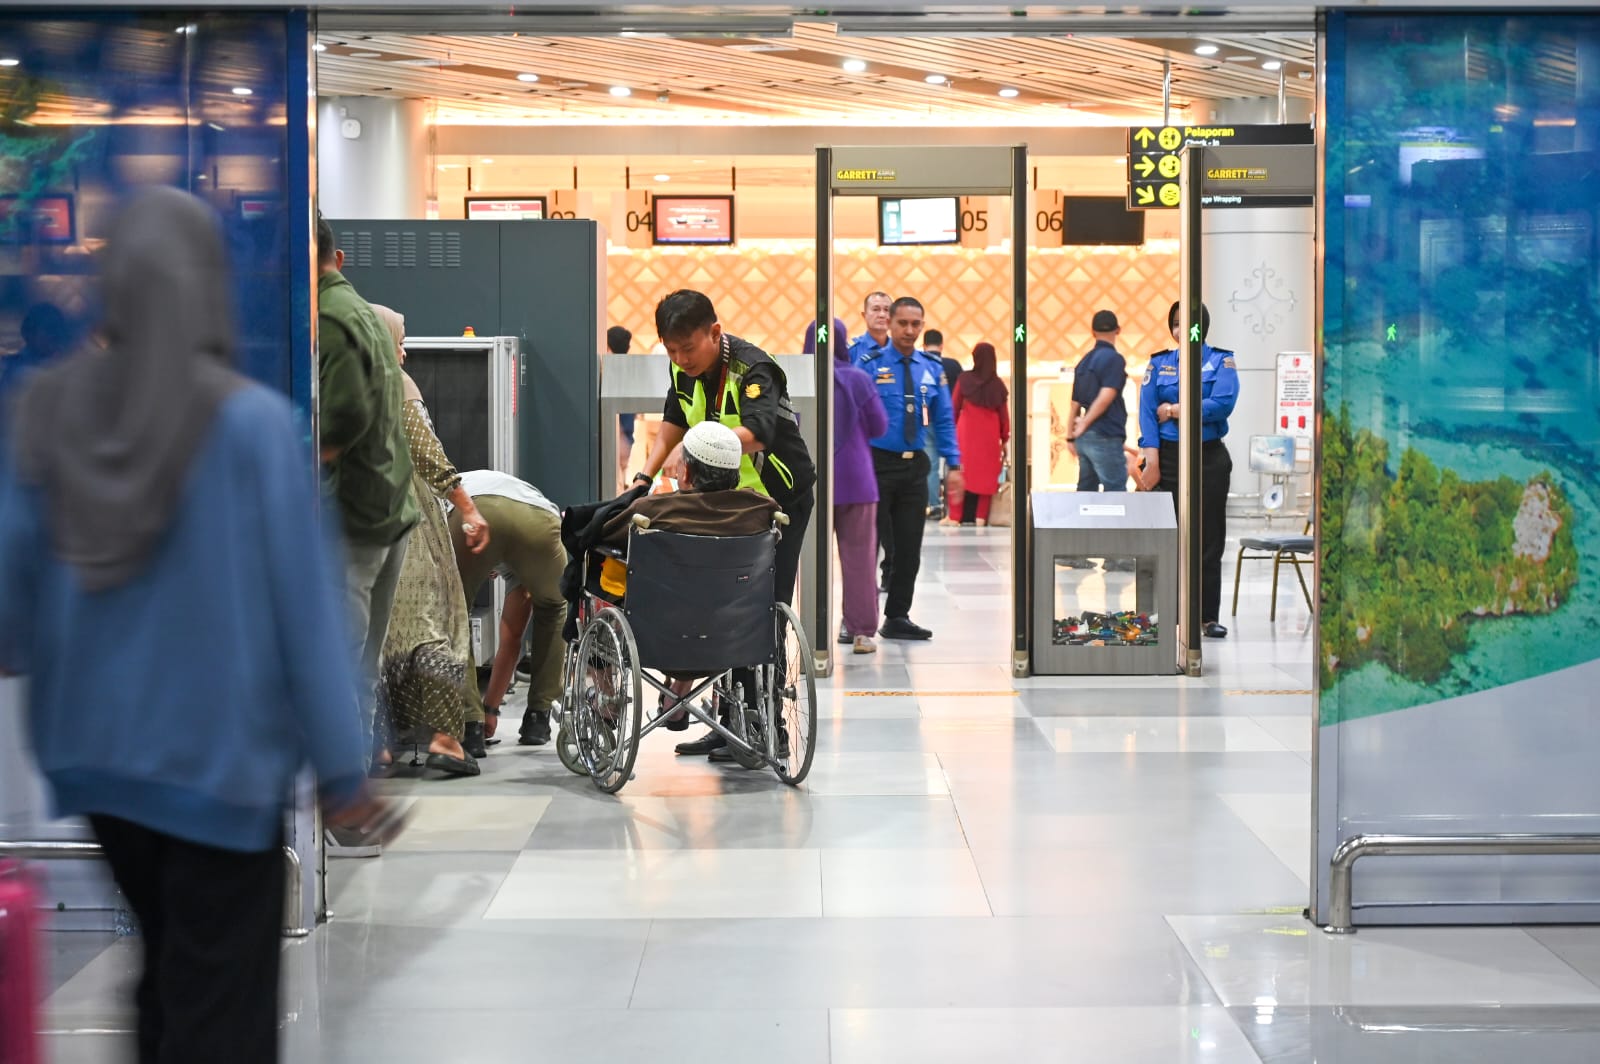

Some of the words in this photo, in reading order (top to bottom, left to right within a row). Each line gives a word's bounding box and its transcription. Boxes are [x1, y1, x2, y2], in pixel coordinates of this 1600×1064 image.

[1184, 126, 1235, 139] Pelaporan
[837, 170, 877, 180] GARRETT
[1207, 169, 1248, 179] GARRETT
[1213, 195, 1242, 204] Wrapping
[626, 210, 652, 232] 04
[961, 210, 988, 232] 05
[1036, 210, 1063, 232] 06
